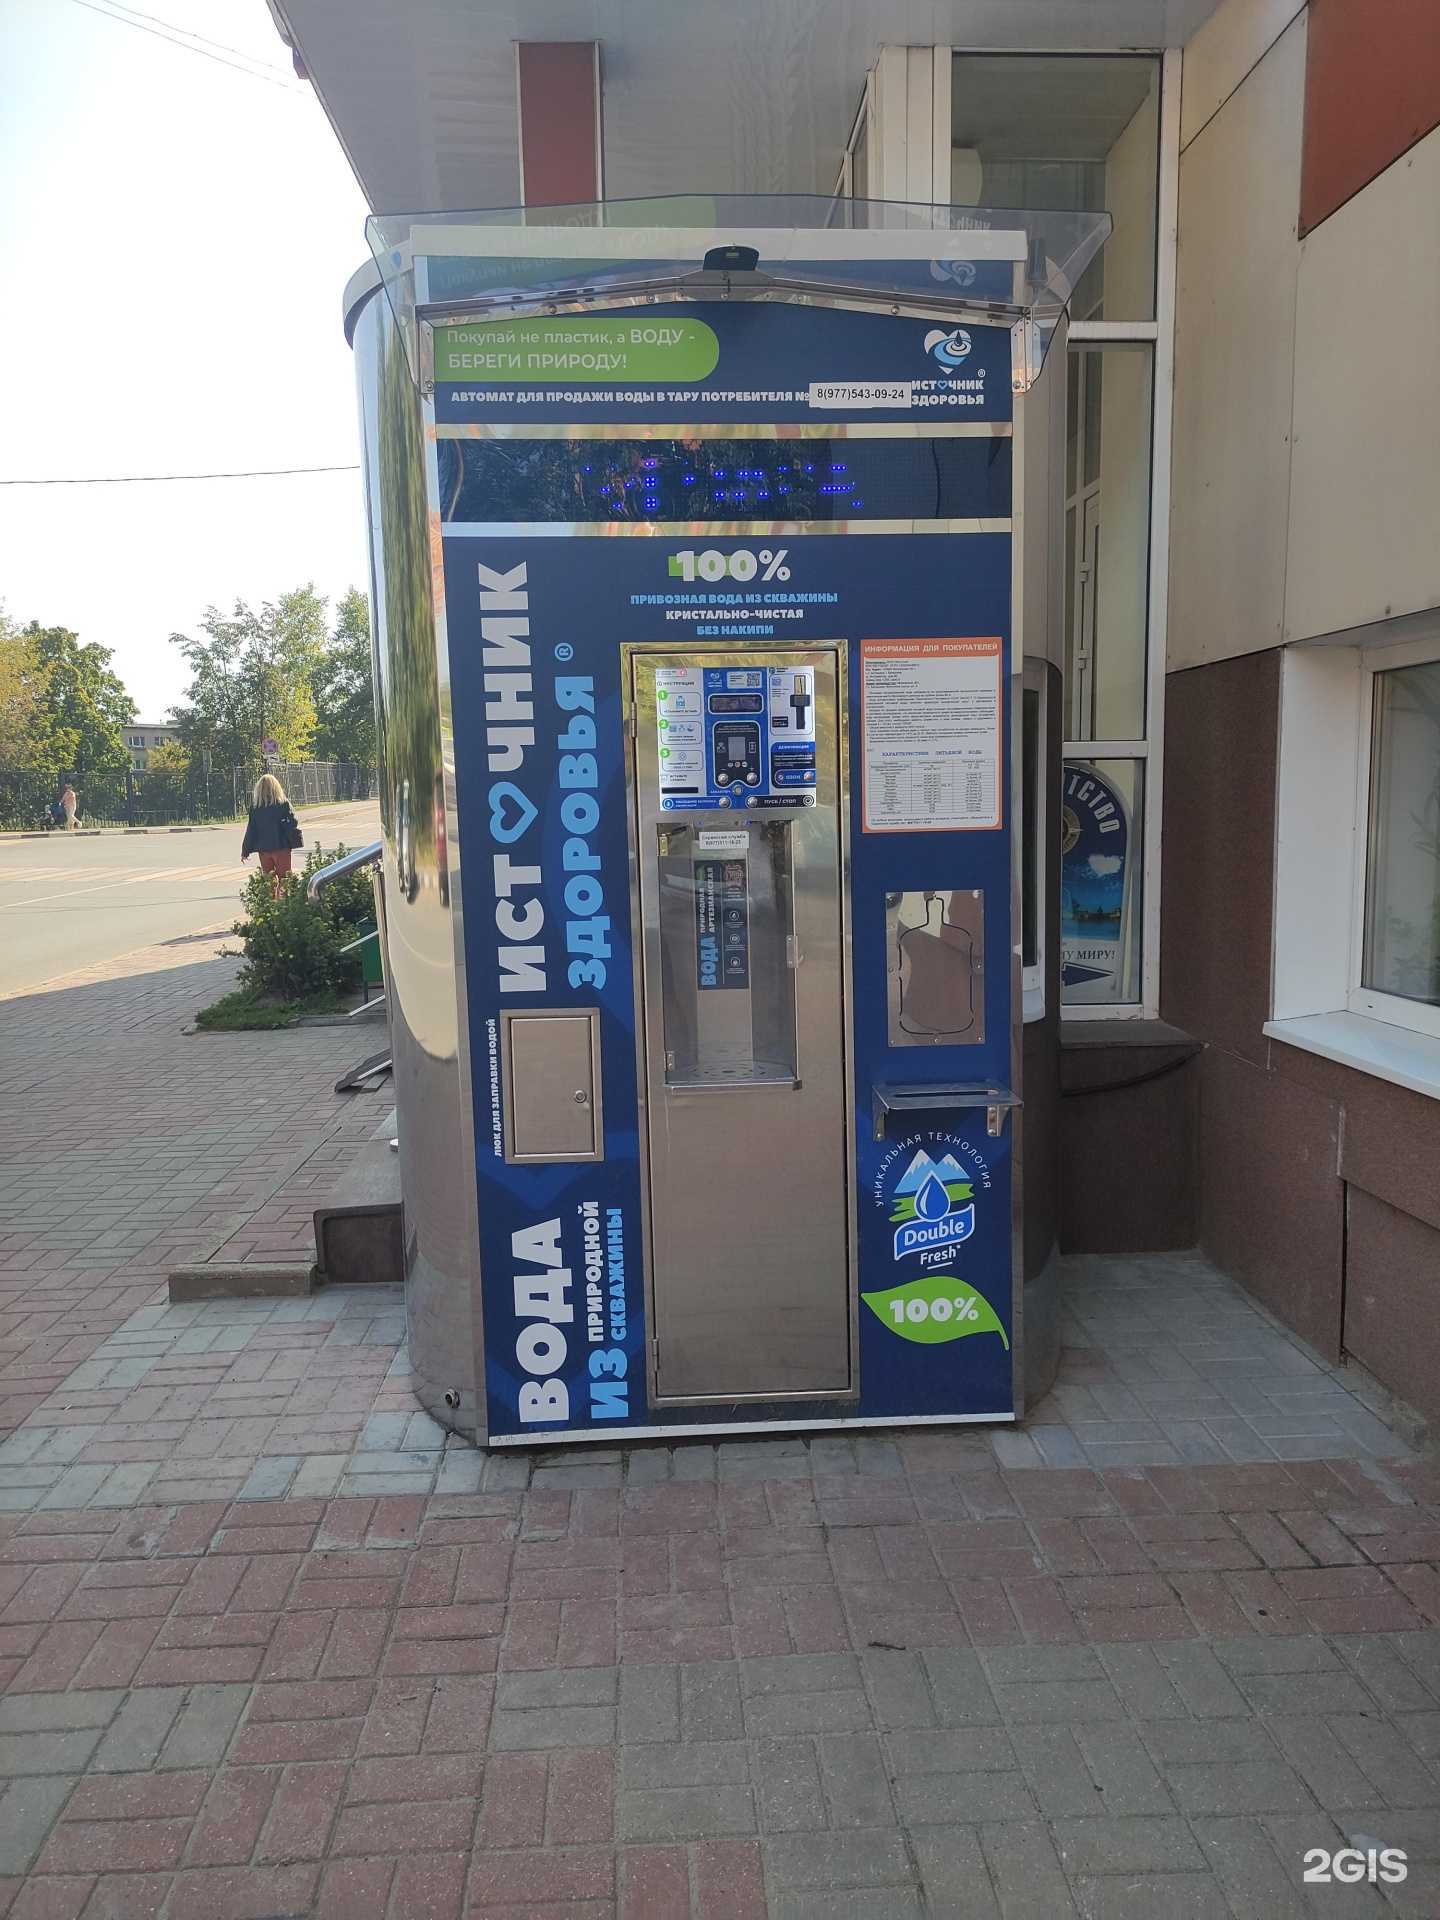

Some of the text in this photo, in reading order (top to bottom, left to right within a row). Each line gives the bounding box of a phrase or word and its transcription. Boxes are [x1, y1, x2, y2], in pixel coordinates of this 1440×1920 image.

[446, 330, 517, 346] Покупай
[521, 332, 541, 343] не
[544, 331, 613, 346] пластик,
[616, 333, 626, 343] а
[630, 328, 684, 345] ВОДУ
[448, 352, 628, 371] БЕРЕГИ ПРИРОДУ!
[450, 391, 515, 404] АВТОМАТ
[516, 391, 545, 404] ДЛЯ
[546, 391, 614, 404] ПРОДАЖИ
[615, 391, 655, 404] ВОДЫ
[656, 391, 665, 403] В
[666, 391, 700, 403] ТАРУ
[701, 391, 793, 404] ПОТРЕБИТЕЛЯ
[817, 388, 905, 401] 8(977)543-09-24
[911, 394, 984, 407] ЗДОРОВЬЯ
[675, 549, 791, 583] 100%
[630, 592, 839, 606] ПРИВОЗНАЯ ВОДА ИЗ СКВАЖИНЫ
[665, 609, 804, 621] КРИСТАЛЬНО-ЧИСТАЯ
[696, 624, 774, 636] БЕЗ НАКИПИ
[864, 642, 998, 654] ИНФОРМАЦИЯ ДЛЯ ПОКУПАТЕЛЕЙ
[554, 676, 612, 991] ЗДОРОВЬЯ
[701, 937, 718, 985] ВОДА
[1077, 950, 1116, 960] МИРУ!
[487, 1018, 502, 1157] ЛЮК ДЛЯ ЗАПРАВКИ ВОДОЙ
[874, 1132, 992, 1207] УНИКАЛЬНАЯ ТЕХНОЛОГИЯ
[904, 1219, 966, 1247] Double
[920, 1245, 957, 1265] Fresh
[577, 1201, 605, 1342] ПРИРОДНОЙ
[606, 1208, 628, 1341] СКВАЖИНЫ
[512, 1217, 574, 1423] ВОДА
[889, 1297, 980, 1324] 100%
[588, 1348, 630, 1420] ИЗ
